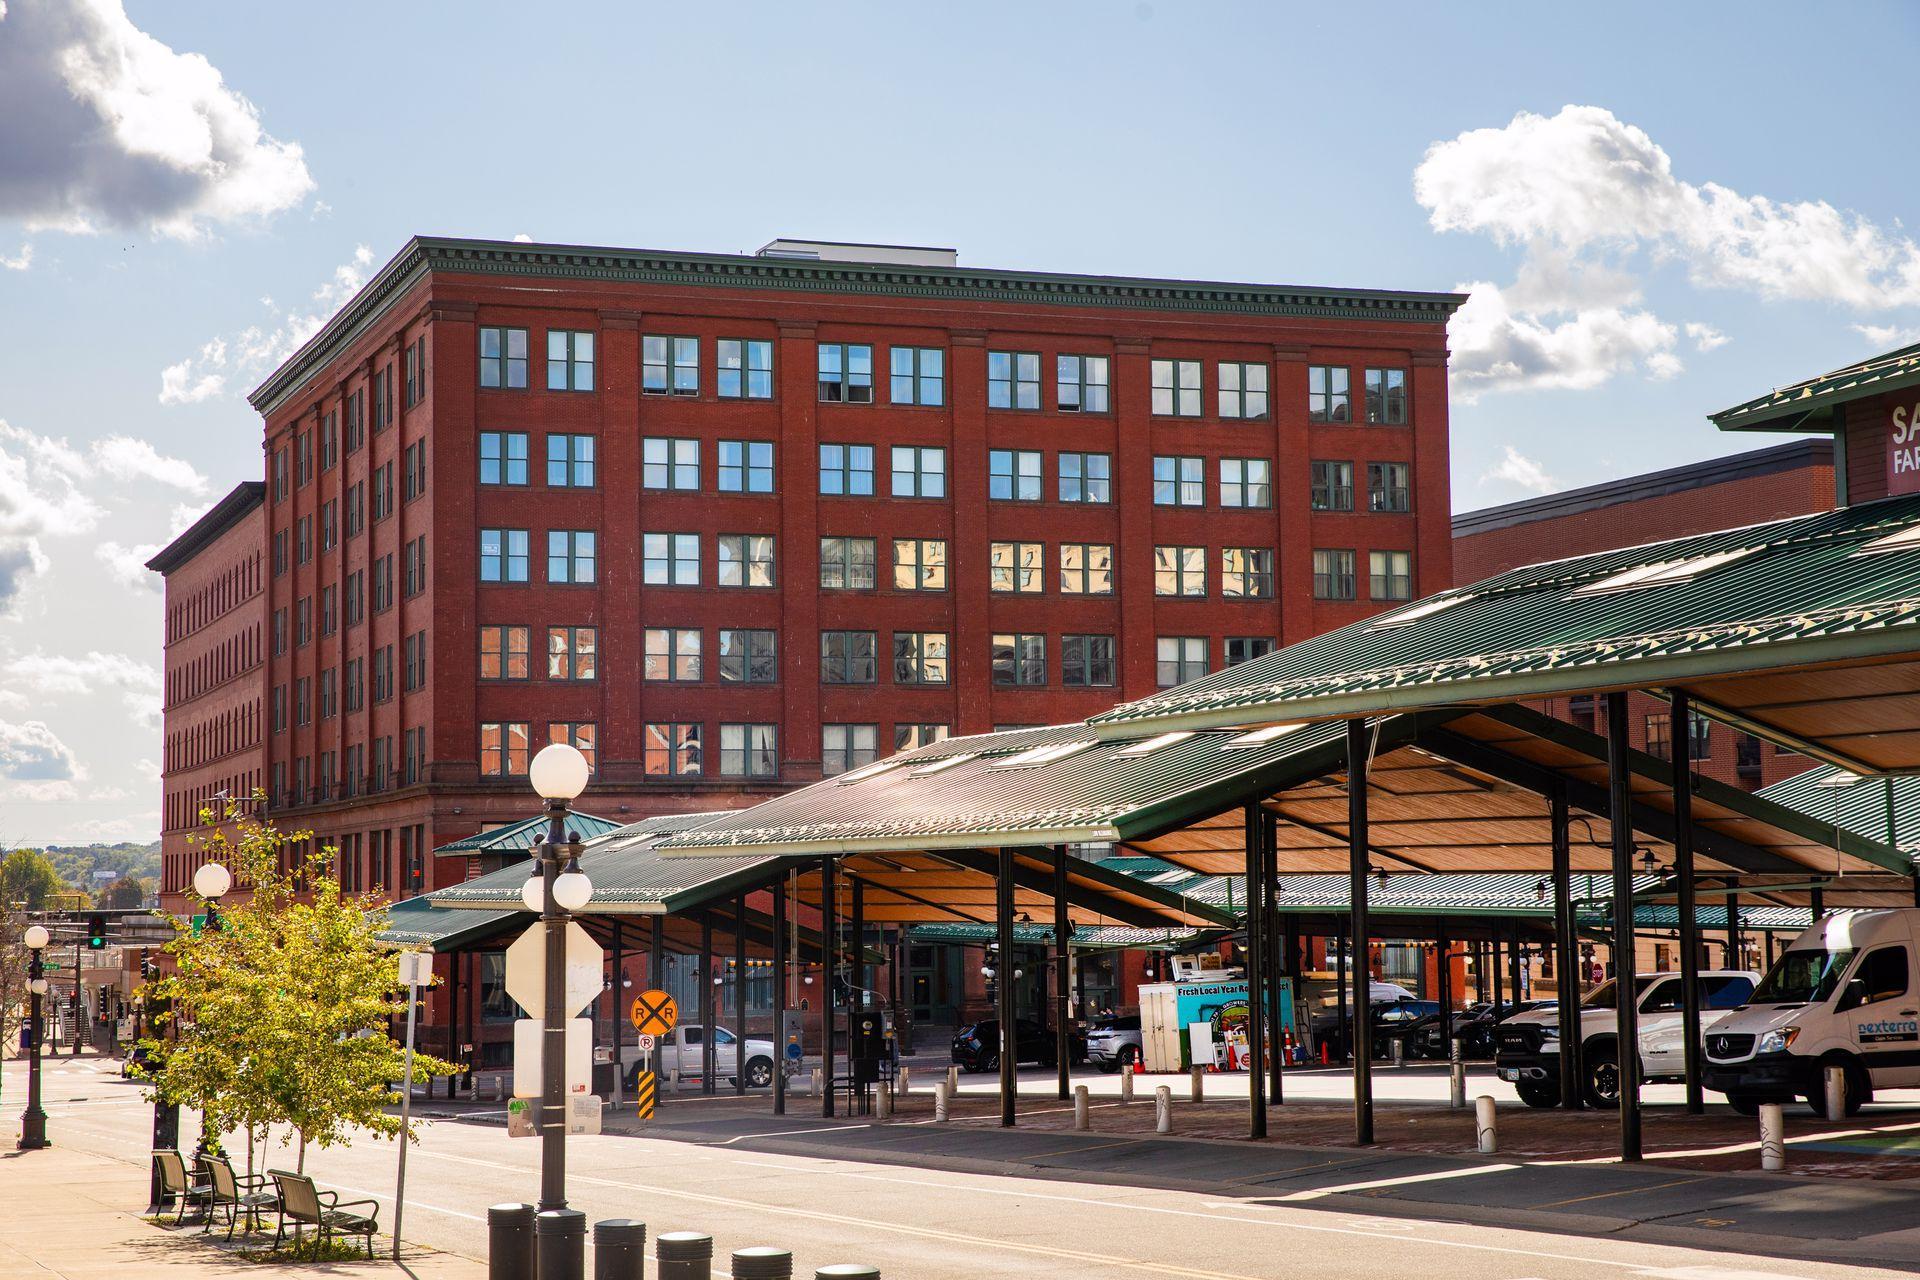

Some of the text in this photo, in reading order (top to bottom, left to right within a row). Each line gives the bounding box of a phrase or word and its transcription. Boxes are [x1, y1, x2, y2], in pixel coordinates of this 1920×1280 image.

[1178, 988, 1199, 996] Fresh
[1200, 986, 1220, 995] Local
[1221, 985, 1238, 994] Year
[635, 1007, 674, 1019] R R
